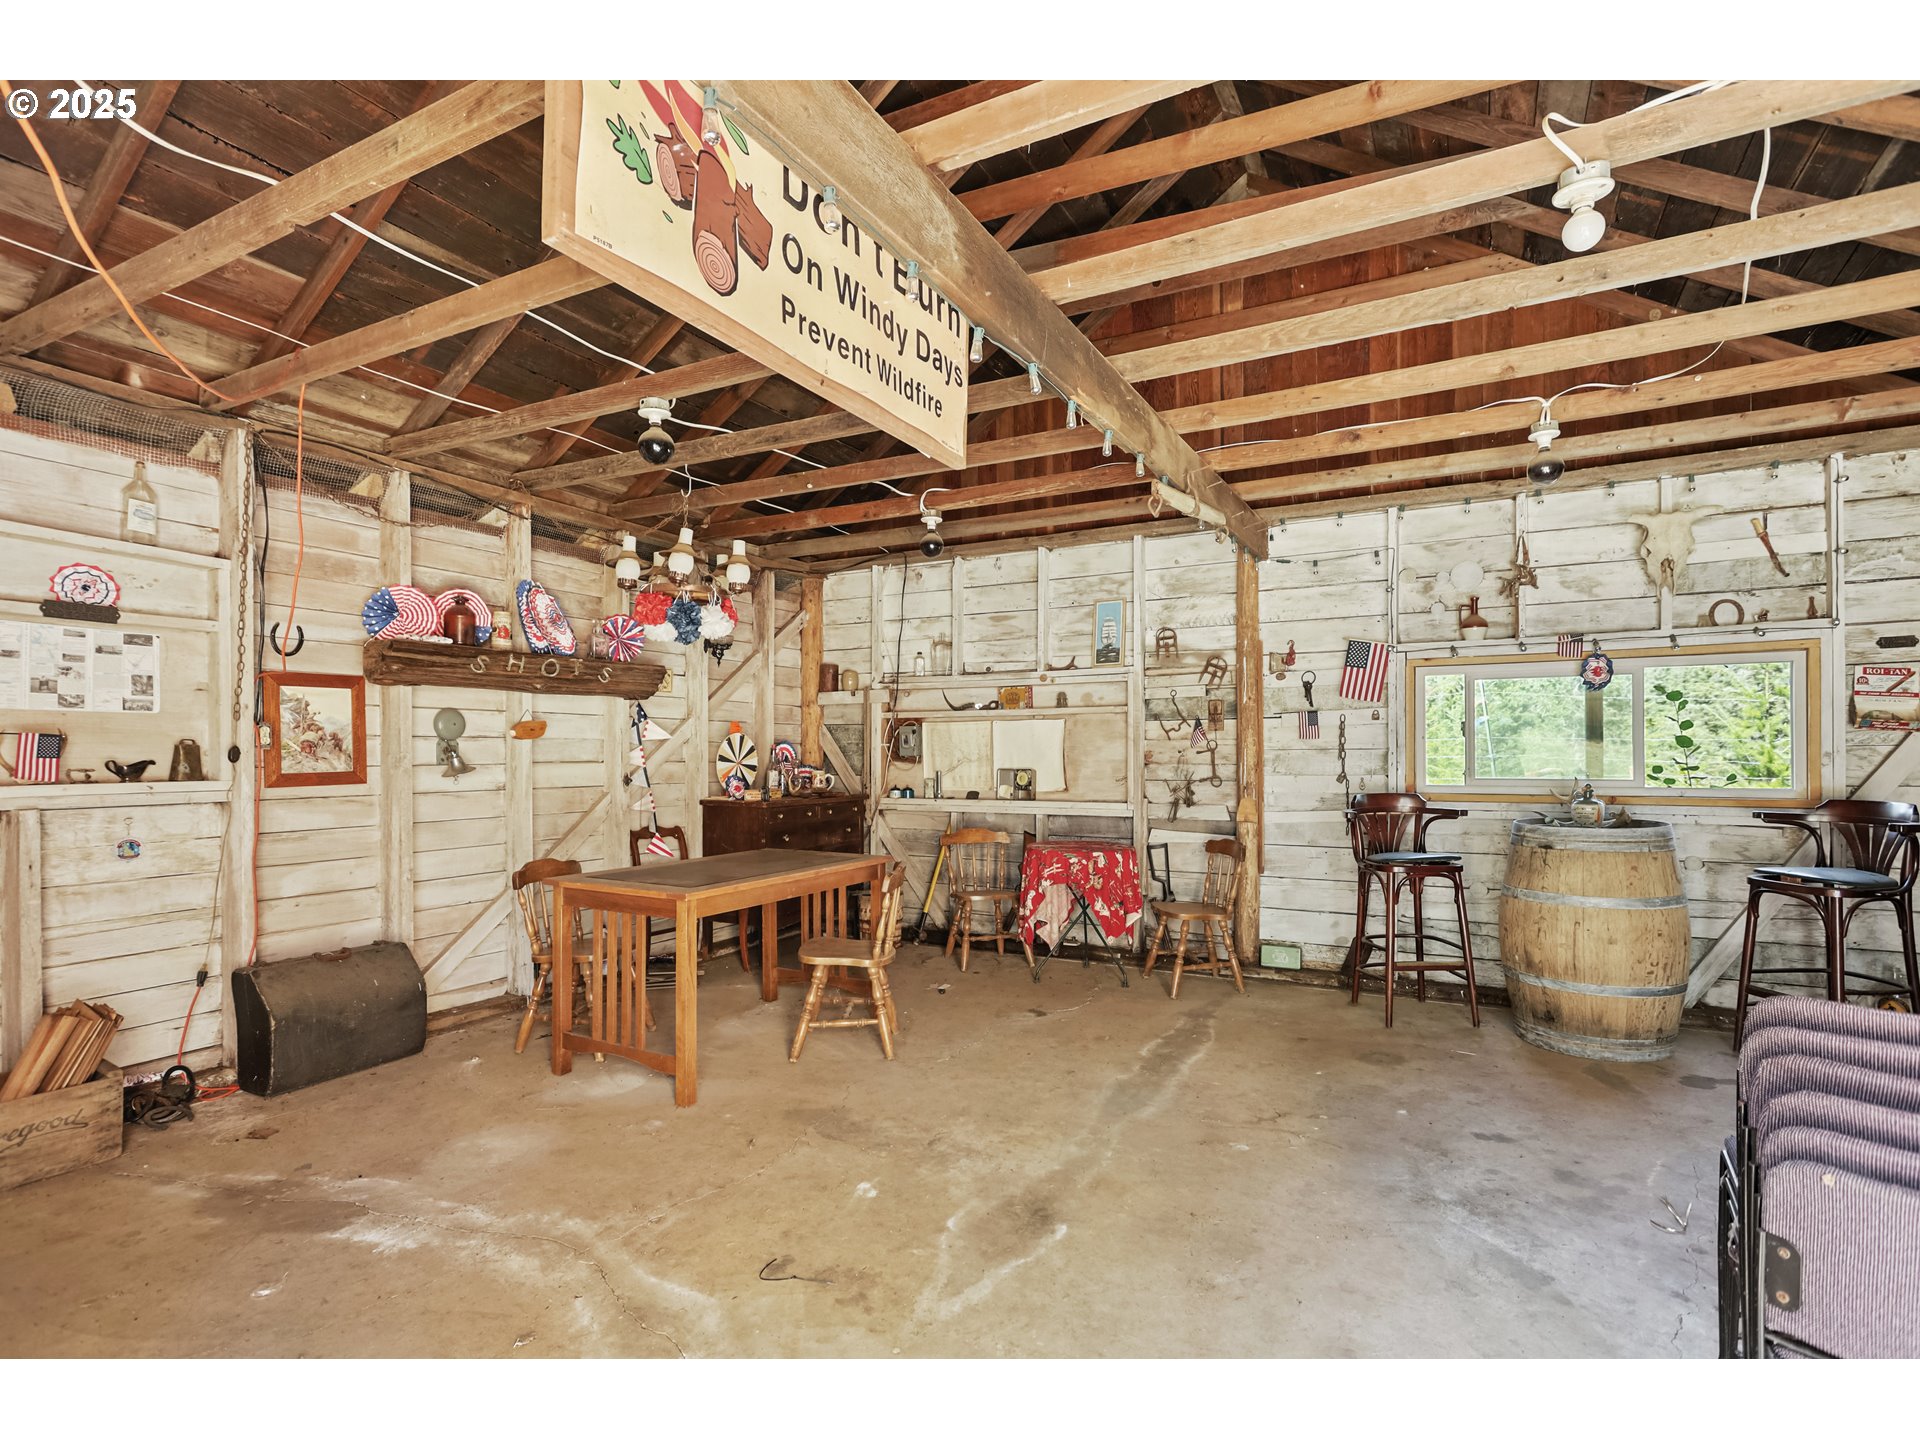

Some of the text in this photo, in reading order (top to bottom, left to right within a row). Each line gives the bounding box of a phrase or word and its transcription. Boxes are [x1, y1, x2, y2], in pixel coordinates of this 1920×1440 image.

[783, 165, 884, 278] Dont
[781, 293, 943, 418] Prevent Wildfire
[782, 233, 963, 388] On Windy Days
[0, 1108, 89, 1147] egood
